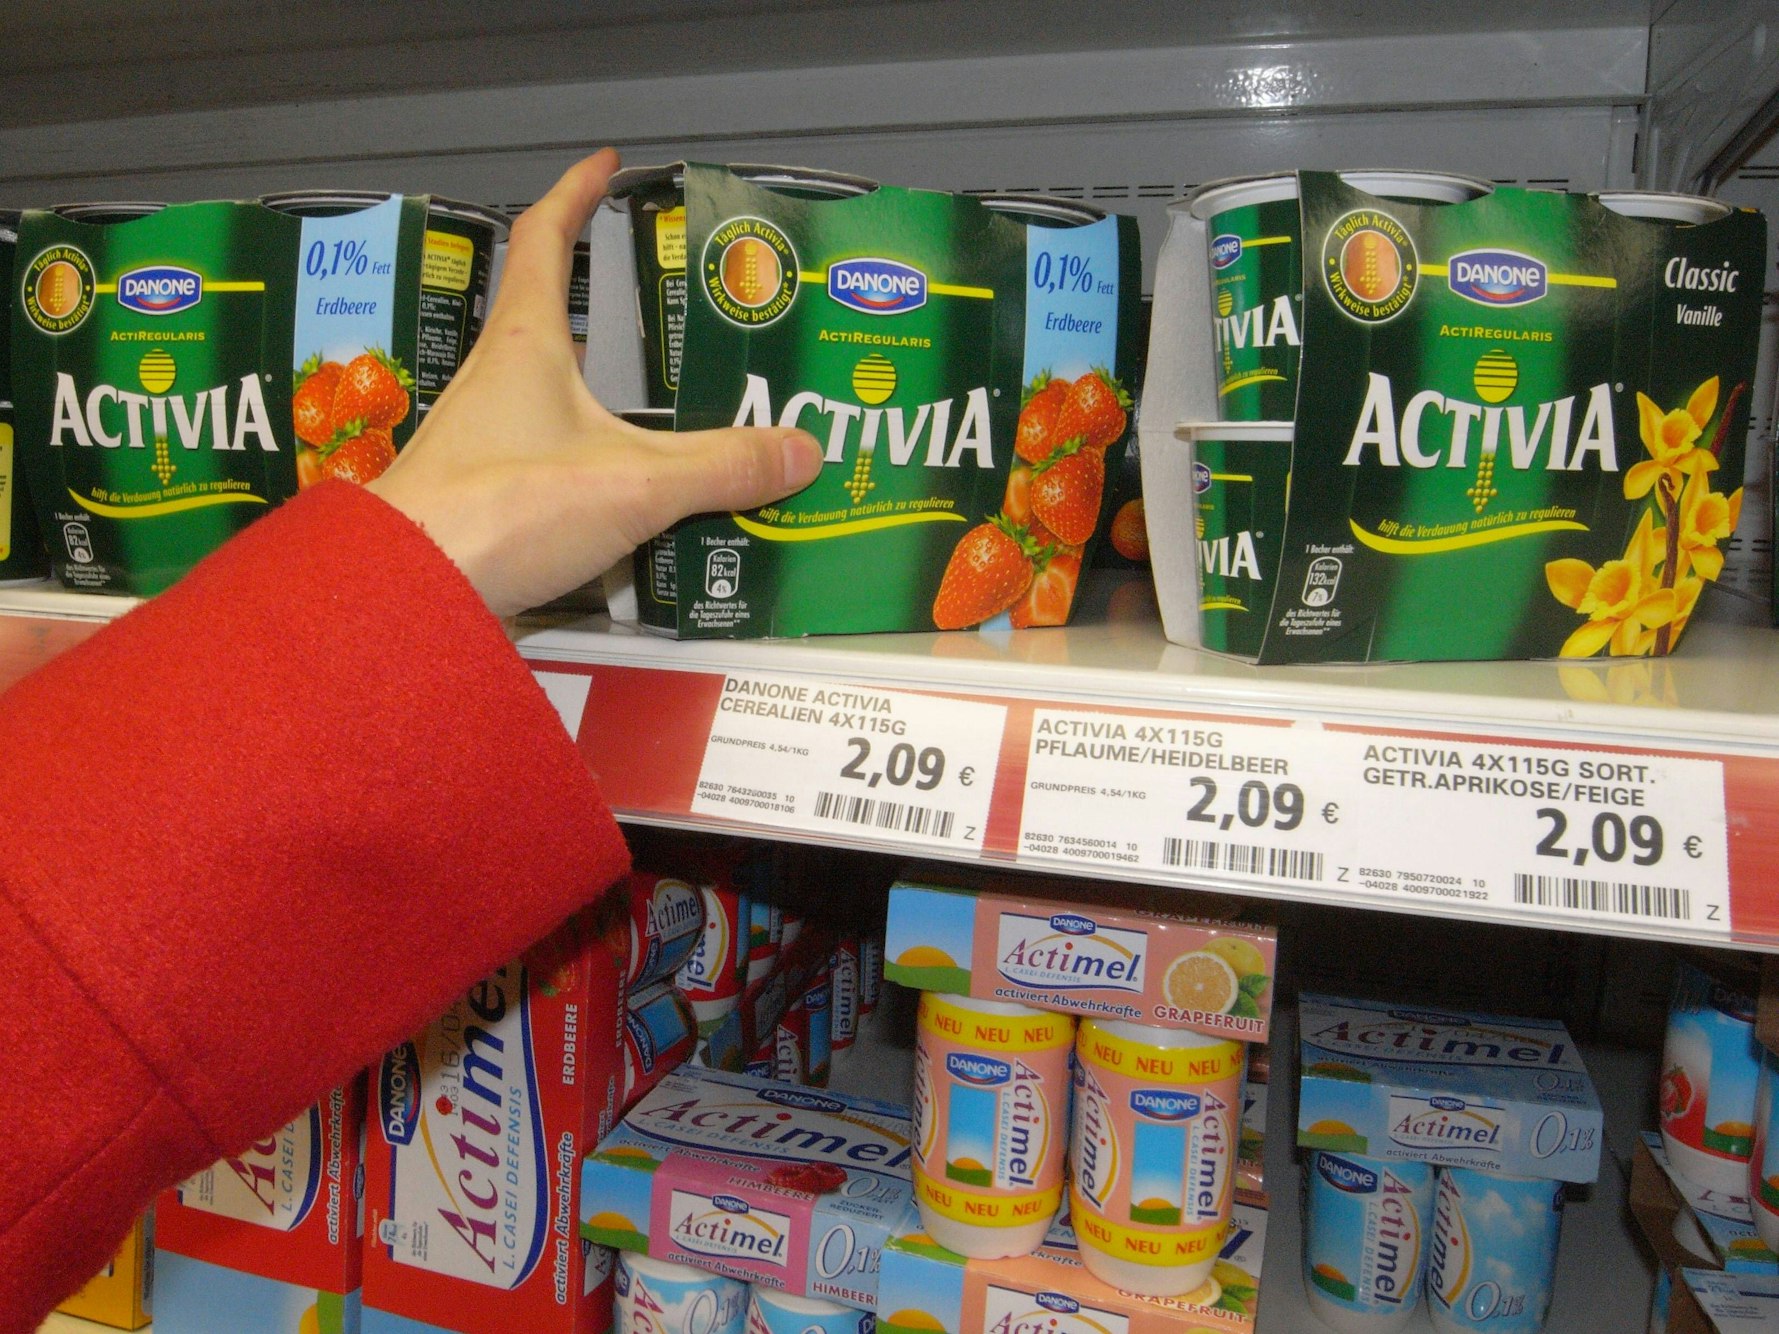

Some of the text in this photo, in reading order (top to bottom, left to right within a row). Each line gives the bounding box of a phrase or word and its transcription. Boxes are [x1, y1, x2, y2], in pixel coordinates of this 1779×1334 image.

[714, 221, 751, 247] Täglich
[1334, 213, 1369, 240] Täglich
[305, 240, 368, 282] 0,1%
[372, 260, 391, 276] Fett
[1034, 251, 1114, 296] 0,1% Fett
[1456, 262, 1541, 288] DANONE
[1664, 256, 1740, 293] Classic
[125, 278, 196, 297] DANONE
[836, 270, 920, 297] DANONE
[1329, 271, 1370, 317] Wirkweise
[316, 297, 377, 317] Erdbeere
[709, 276, 750, 322] Wirkweise
[1045, 311, 1103, 334] Erdbeere
[1676, 304, 1723, 327] Vanille
[50, 371, 280, 453] ACTIVIA
[1342, 372, 1618, 473] ACTIVIA
[91, 478, 251, 504] hilft die Verdauung natürlich zu regulieren
[781, 497, 955, 524] die Verdauung natürlich zu regulieren
[1377, 505, 1576, 539] hilft die Verdauung natürlich zu regulieren
[706, 536, 726, 546] Becher
[1310, 543, 1331, 554] Becher
[713, 554, 736, 563] Kalorien
[1315, 562, 1339, 571] Kalorien
[689, 610, 699, 619] die
[735, 611, 750, 619] eines
[693, 600, 704, 610] des
[738, 600, 748, 610] für
[1286, 608, 1297, 617] des
[725, 678, 893, 714] DANONE ACTIVIA
[720, 697, 907, 737] CEREALIEN 4X115G
[710, 735, 767, 750] GRUNDPREIS
[1037, 718, 1224, 748] ACTIVIA 4X115G
[839, 736, 976, 792] 2,09 €
[1035, 738, 1289, 776] PFLAUME/HEIDELBEER
[1363, 744, 1656, 785] ACTIVIA 4X115G SORT.
[698, 780, 795, 803] 82630 10
[1030, 781, 1096, 796] GRUNDPREIS
[1363, 768, 1646, 808] GETR.APRIKOSE/FEIGE
[728, 796, 795, 814] 4009700018106
[1186, 776, 1339, 831] 2,09 €
[963, 826, 977, 841] Z
[1024, 832, 1138, 852] 82630 7634560014 10
[1535, 807, 1704, 867] 2,09 €
[1062, 847, 1140, 863] 4009700019462
[1337, 866, 1349, 882] Z
[1359, 867, 1486, 889] 82630 7950720024 10
[1402, 884, 1489, 901] 4009700021922
[1053, 918, 1094, 931] DANONE
[1706, 904, 1721, 922] Z
[1003, 938, 1141, 982] Actimel
[995, 987, 1142, 1018] activiert Abwehrkräfte
[934, 1013, 1055, 1043] NEU NEU NEU
[1154, 1005, 1264, 1033] GRAPEFRUIT
[562, 1003, 578, 1086] ERDBEERE
[1311, 1020, 1565, 1064] Actimel
[950, 1056, 1008, 1078] DANONE
[1093, 1040, 1221, 1077] NEU NEU NEU
[764, 1090, 840, 1111] DANONE
[1135, 1093, 1198, 1111] DANONE
[437, 970, 506, 1274] Actime
[1009, 1060, 1041, 1185] Actimel
[1393, 1114, 1500, 1144] Actimel
[655, 1121, 791, 1154] CASEI DEFENSIS
[1082, 1071, 1108, 1208] Actimel
[282, 1140, 295, 1194] CASEI
[327, 1084, 345, 1245] activiert Abwehrkräfte
[618, 1139, 762, 1172] activiert Abwehrkräfte
[1197, 1091, 1227, 1217] Actimel
[1386, 1150, 1501, 1170] activiert Abwehrkräfte
[504, 1087, 522, 1252] CASEI DEFENSIS
[1319, 1155, 1374, 1187] DANONE
[728, 1176, 816, 1202] HIMBEERE
[926, 1185, 1042, 1217] NEU NEU NEU
[556, 1132, 574, 1304] activiert Abwehrkräfte
[675, 1212, 785, 1257] Actimel
[1084, 1219, 1112, 1244] NEU
[1125, 1237, 1162, 1255] NEU
[1176, 1236, 1208, 1255] NEU
[1376, 1168, 1412, 1304] Actimel
[668, 1253, 786, 1289] activiert Abwehrkräfte
[813, 1281, 879, 1306] HIMBEER
[1039, 1294, 1078, 1309] DANONE
